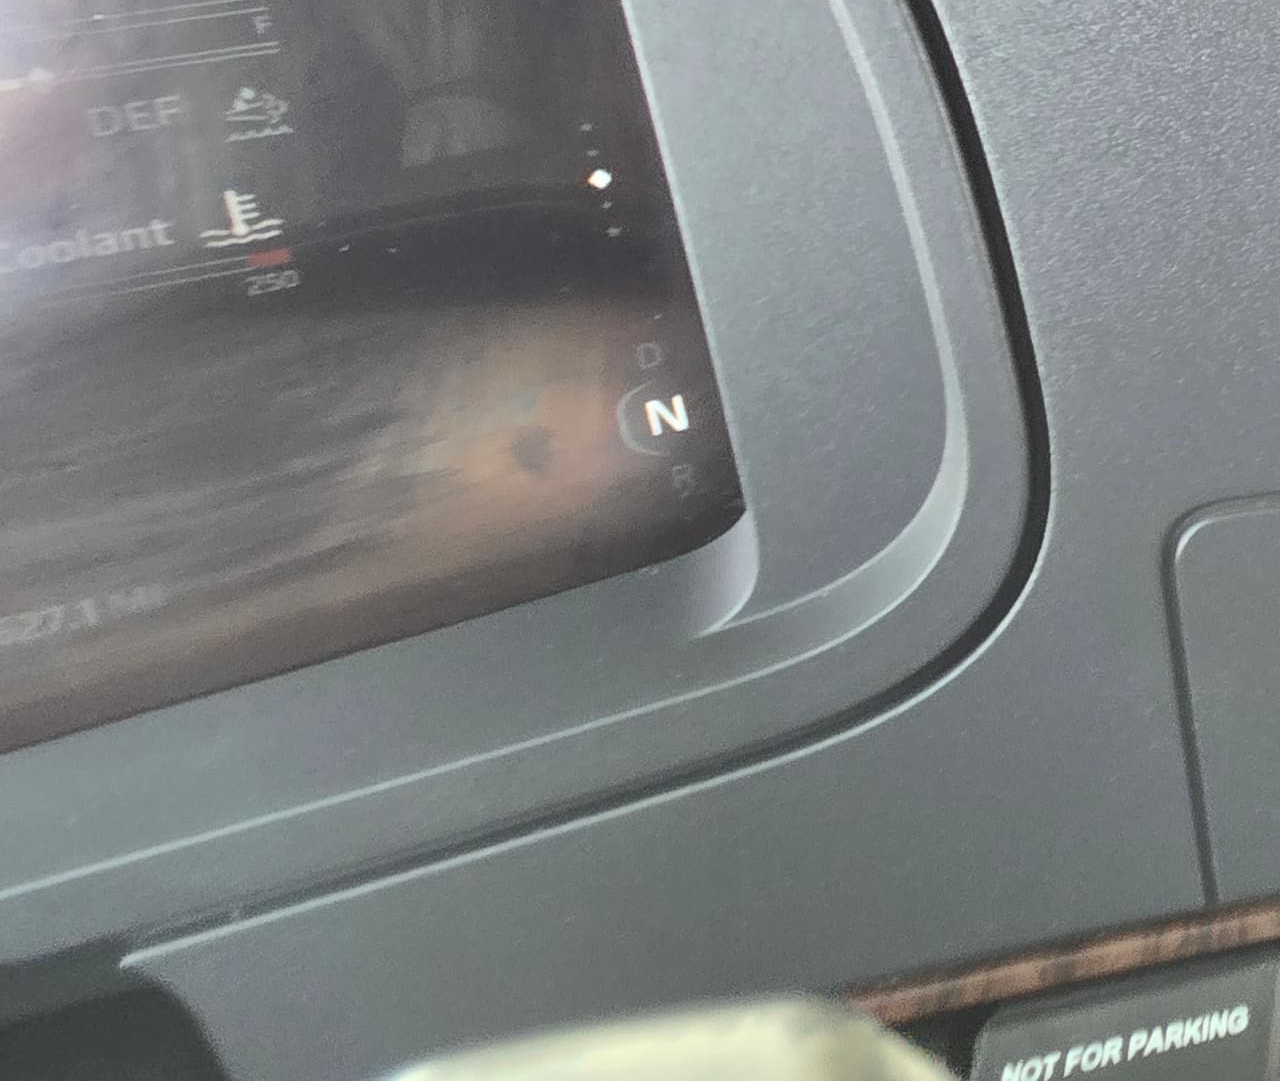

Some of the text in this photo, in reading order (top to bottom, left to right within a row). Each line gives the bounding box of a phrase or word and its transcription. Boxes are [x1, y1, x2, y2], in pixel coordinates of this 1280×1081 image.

[87, 93, 183, 138] DEF
[0, 219, 176, 271] oolant
[645, 394, 690, 437] N
[1000, 1003, 1250, 1081] NOT FOR PARKING
